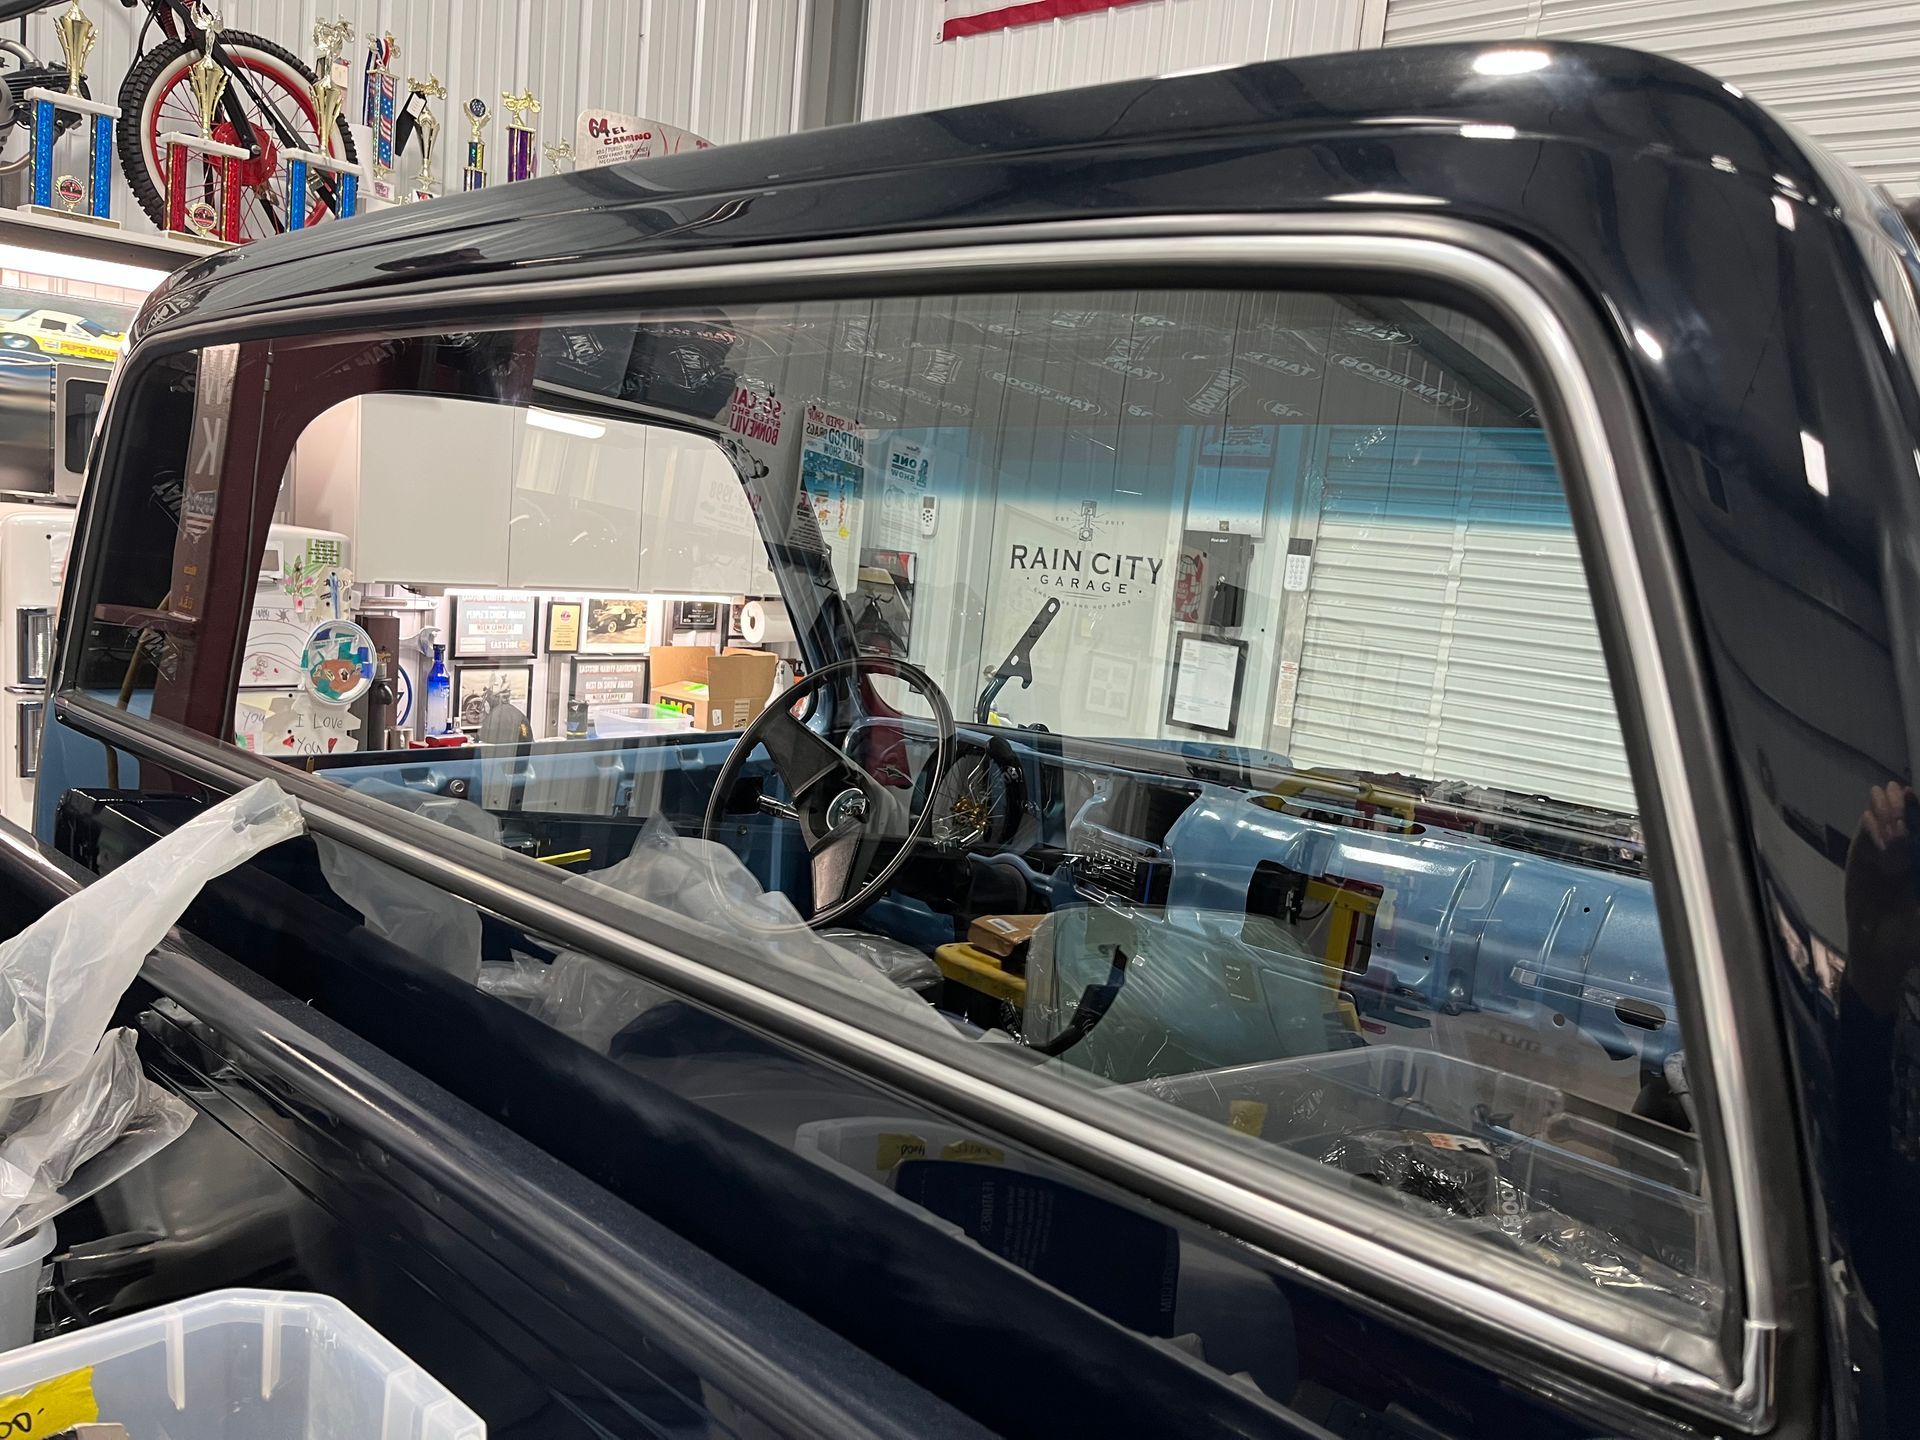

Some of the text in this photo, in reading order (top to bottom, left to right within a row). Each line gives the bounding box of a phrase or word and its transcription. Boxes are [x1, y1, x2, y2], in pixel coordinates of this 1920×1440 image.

[588, 117, 627, 138] 64 EL
[603, 132, 652, 146] CAMINO
[1010, 544, 1163, 585] RAIN CITY
[1040, 574, 1128, 595] GARAGE
[1111, 599, 1132, 608] RODS
[296, 713, 304, 728] I
